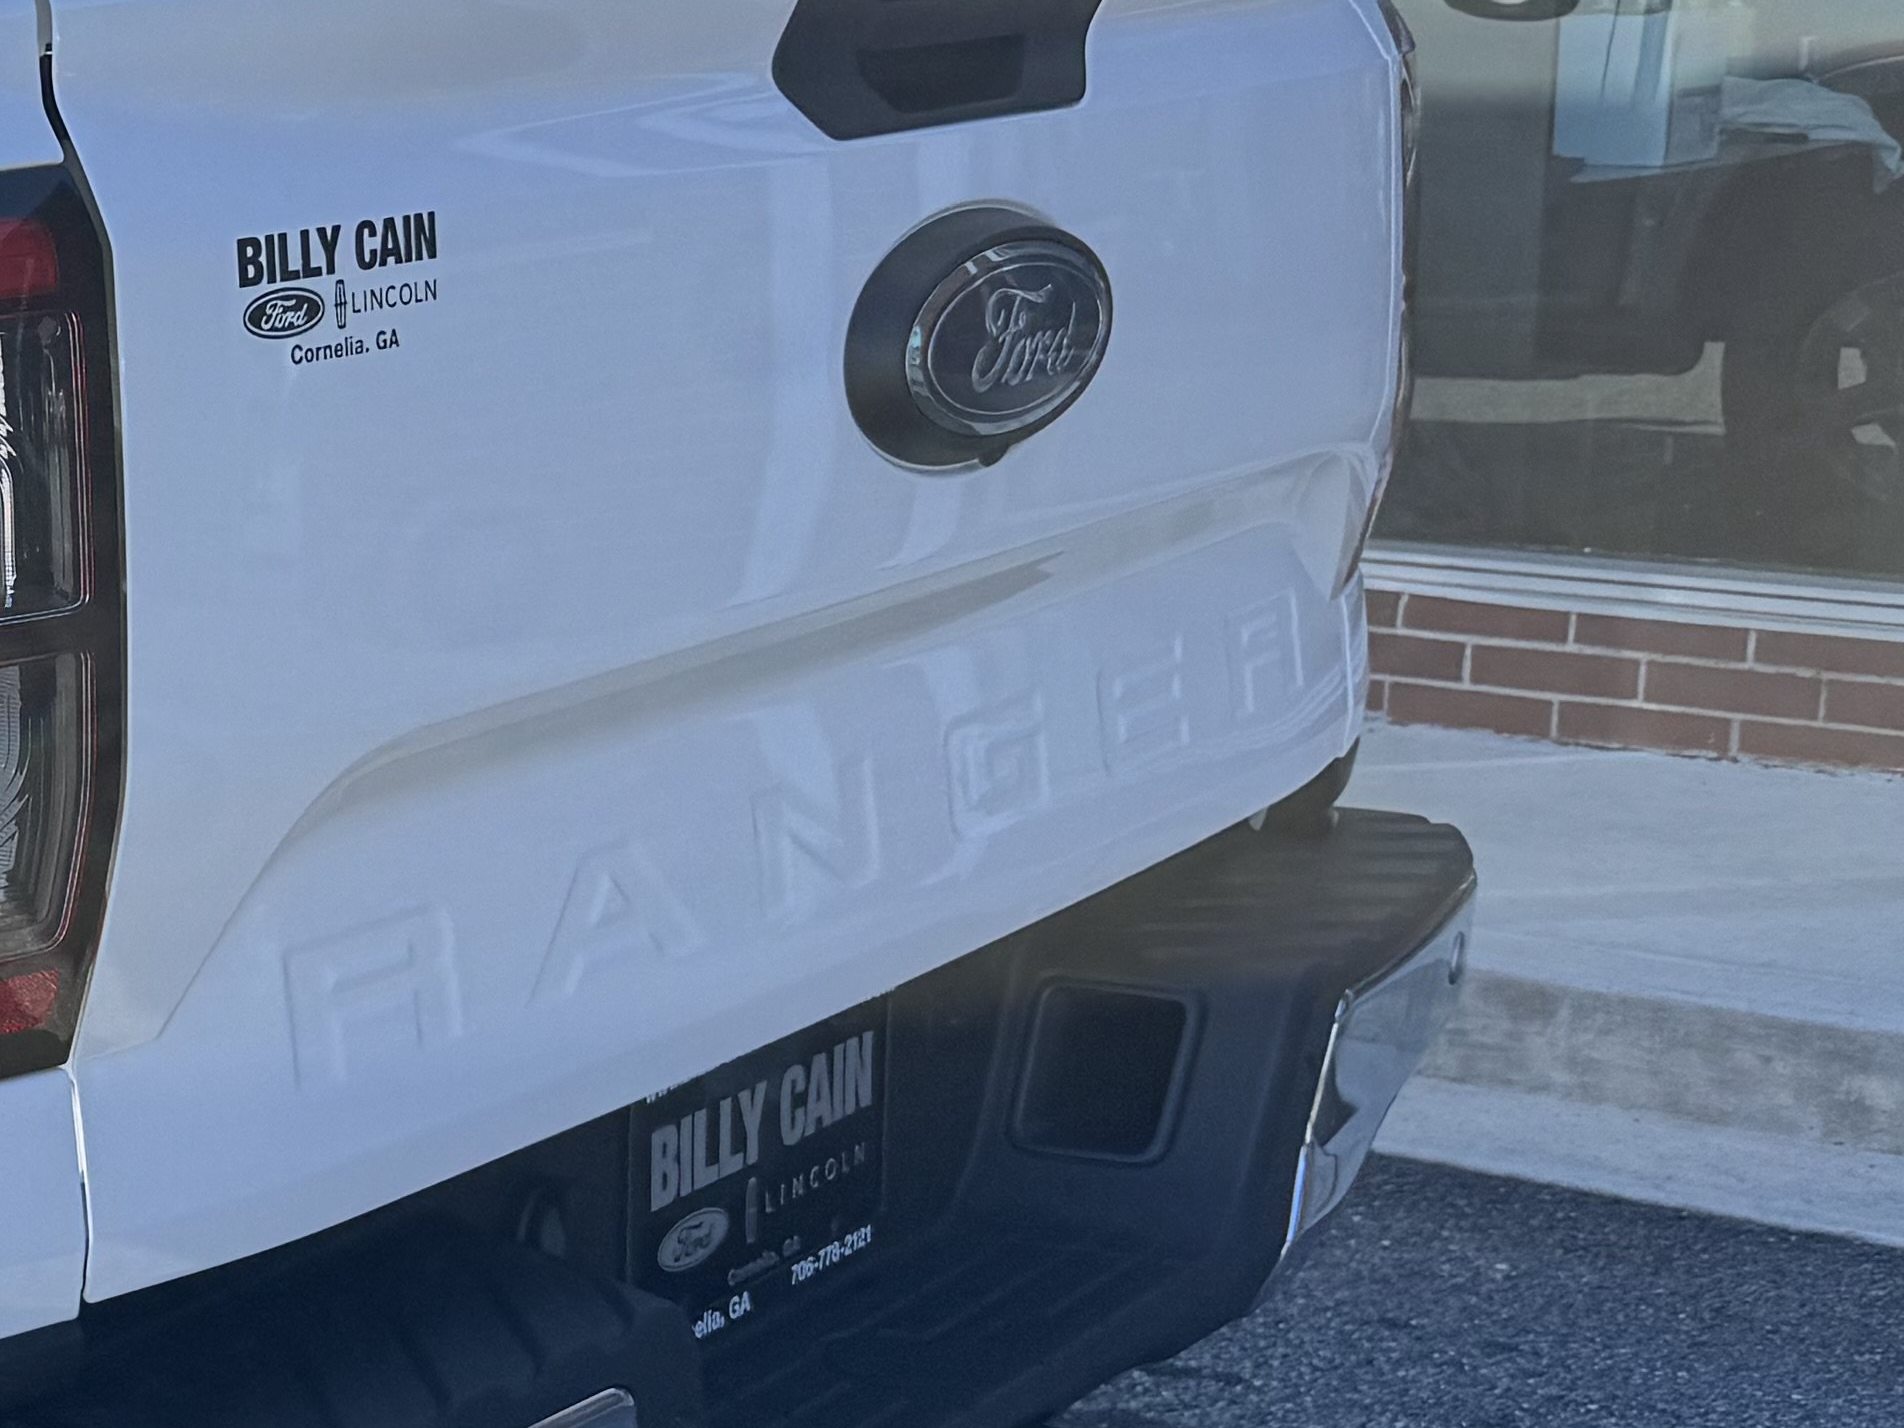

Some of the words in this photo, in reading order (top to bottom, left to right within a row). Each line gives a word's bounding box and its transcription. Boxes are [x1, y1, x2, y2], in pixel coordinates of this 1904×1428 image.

[236, 224, 342, 289] BILLY
[354, 210, 438, 270] CAIN
[260, 298, 310, 331] Ford
[351, 279, 438, 314] LINCOLN
[375, 328, 400, 351] GA
[971, 283, 1077, 394] Ford
[282, 585, 1305, 1090] RANGER
[650, 1080, 767, 1213] BILLY
[779, 1030, 875, 1147] CAIN
[765, 1141, 866, 1214] LINCOLN
[729, 1290, 752, 1320] GA
